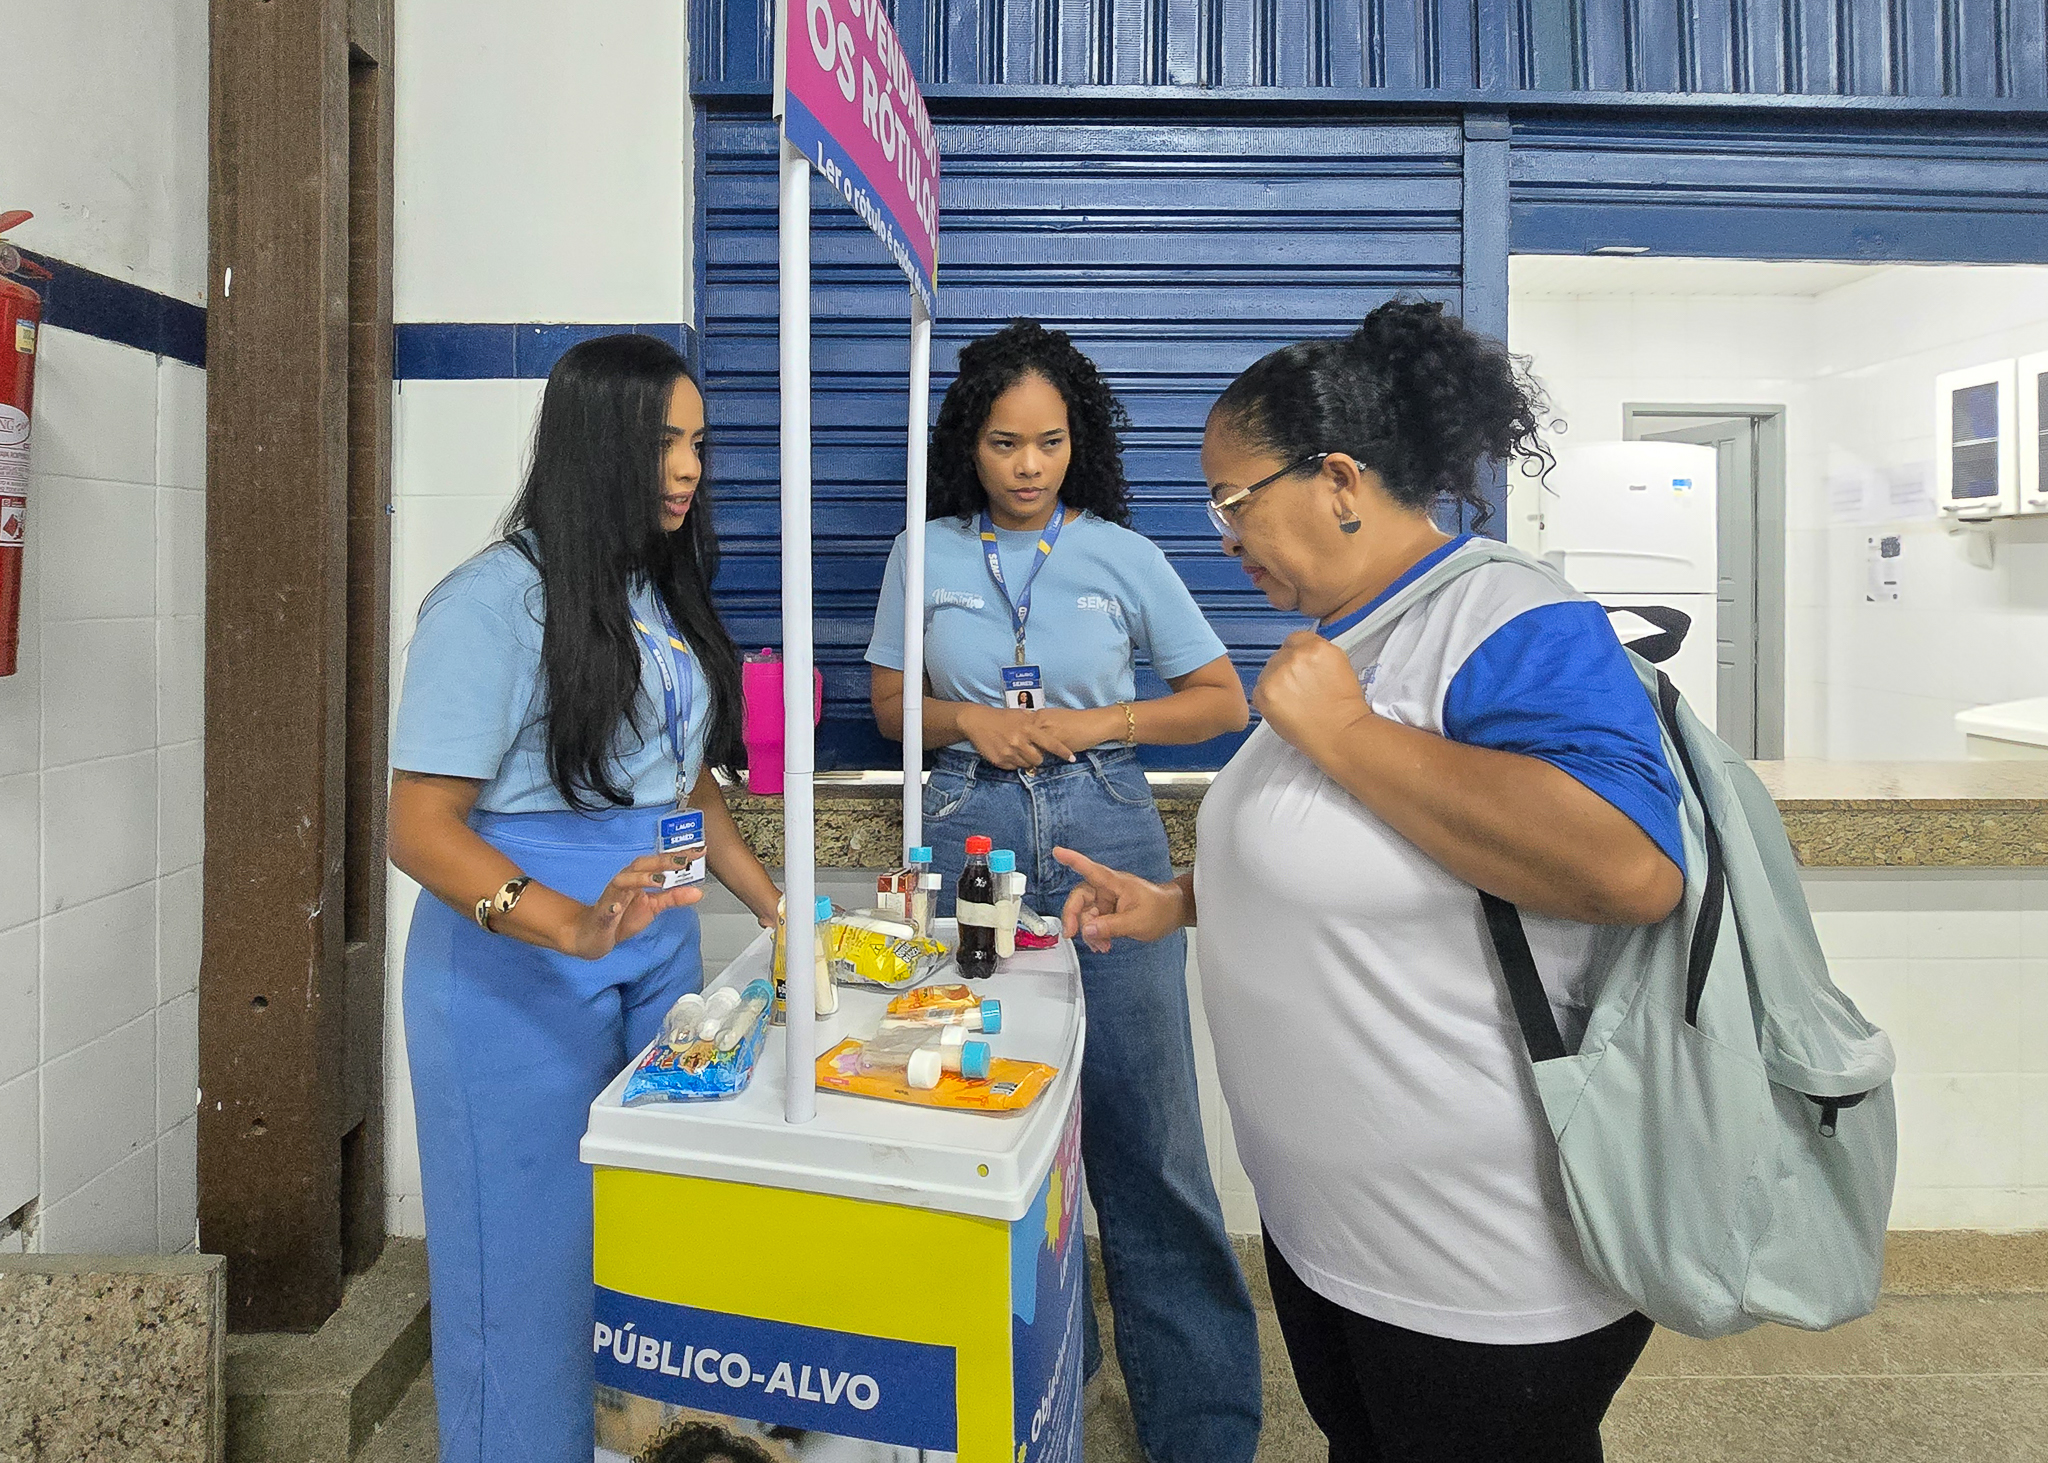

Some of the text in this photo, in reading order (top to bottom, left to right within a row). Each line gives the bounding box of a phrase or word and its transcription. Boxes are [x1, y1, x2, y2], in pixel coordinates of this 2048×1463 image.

[806, 0, 936, 250] OS RÓTULOS
[817, 140, 842, 189] Ler
[843, 177, 852, 202] o
[854, 187, 887, 242] rótulo
[670, 833, 695, 845] SEMED
[675, 821, 696, 831] LAURO
[593, 1322, 880, 1411] PÚBLICO-ALVO
